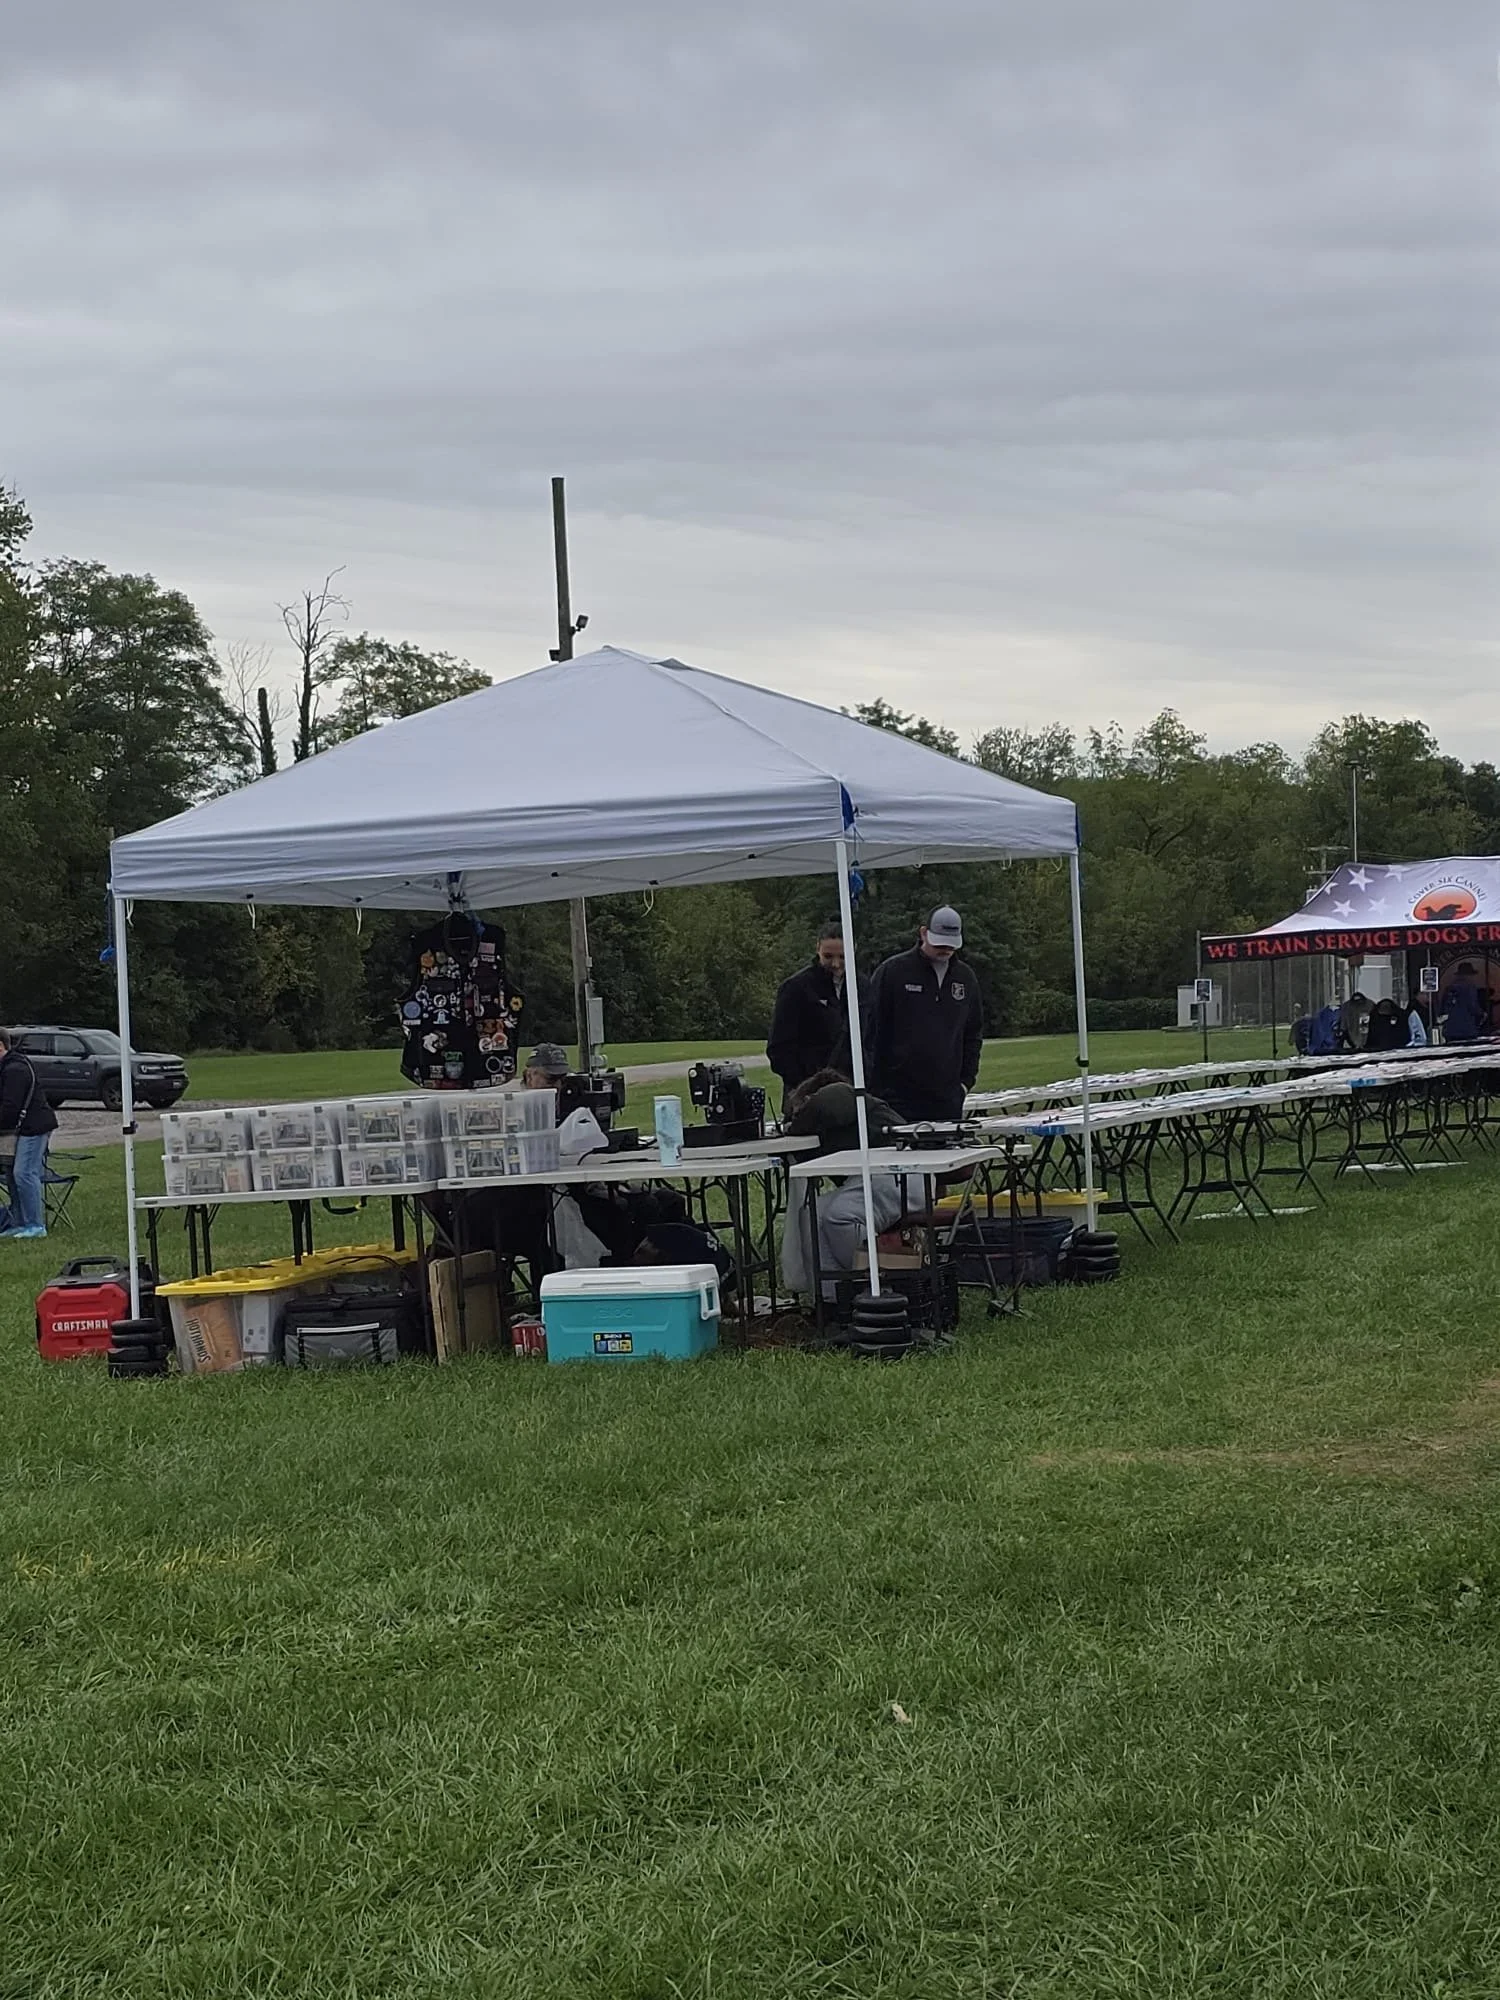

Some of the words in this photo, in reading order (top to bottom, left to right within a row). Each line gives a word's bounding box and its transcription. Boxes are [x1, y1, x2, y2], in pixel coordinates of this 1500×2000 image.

[1408, 882, 1436, 904] COVER
[1436, 876, 1453, 885] SIX
[1208, 943, 1237, 958] WE
[1243, 937, 1309, 956] TRAIN
[1315, 931, 1402, 950] SERVICE
[1407, 926, 1470, 945] DOGS
[52, 1319, 109, 1332] CRAFTSMAN
[185, 1318, 211, 1364] HOTHANDS
